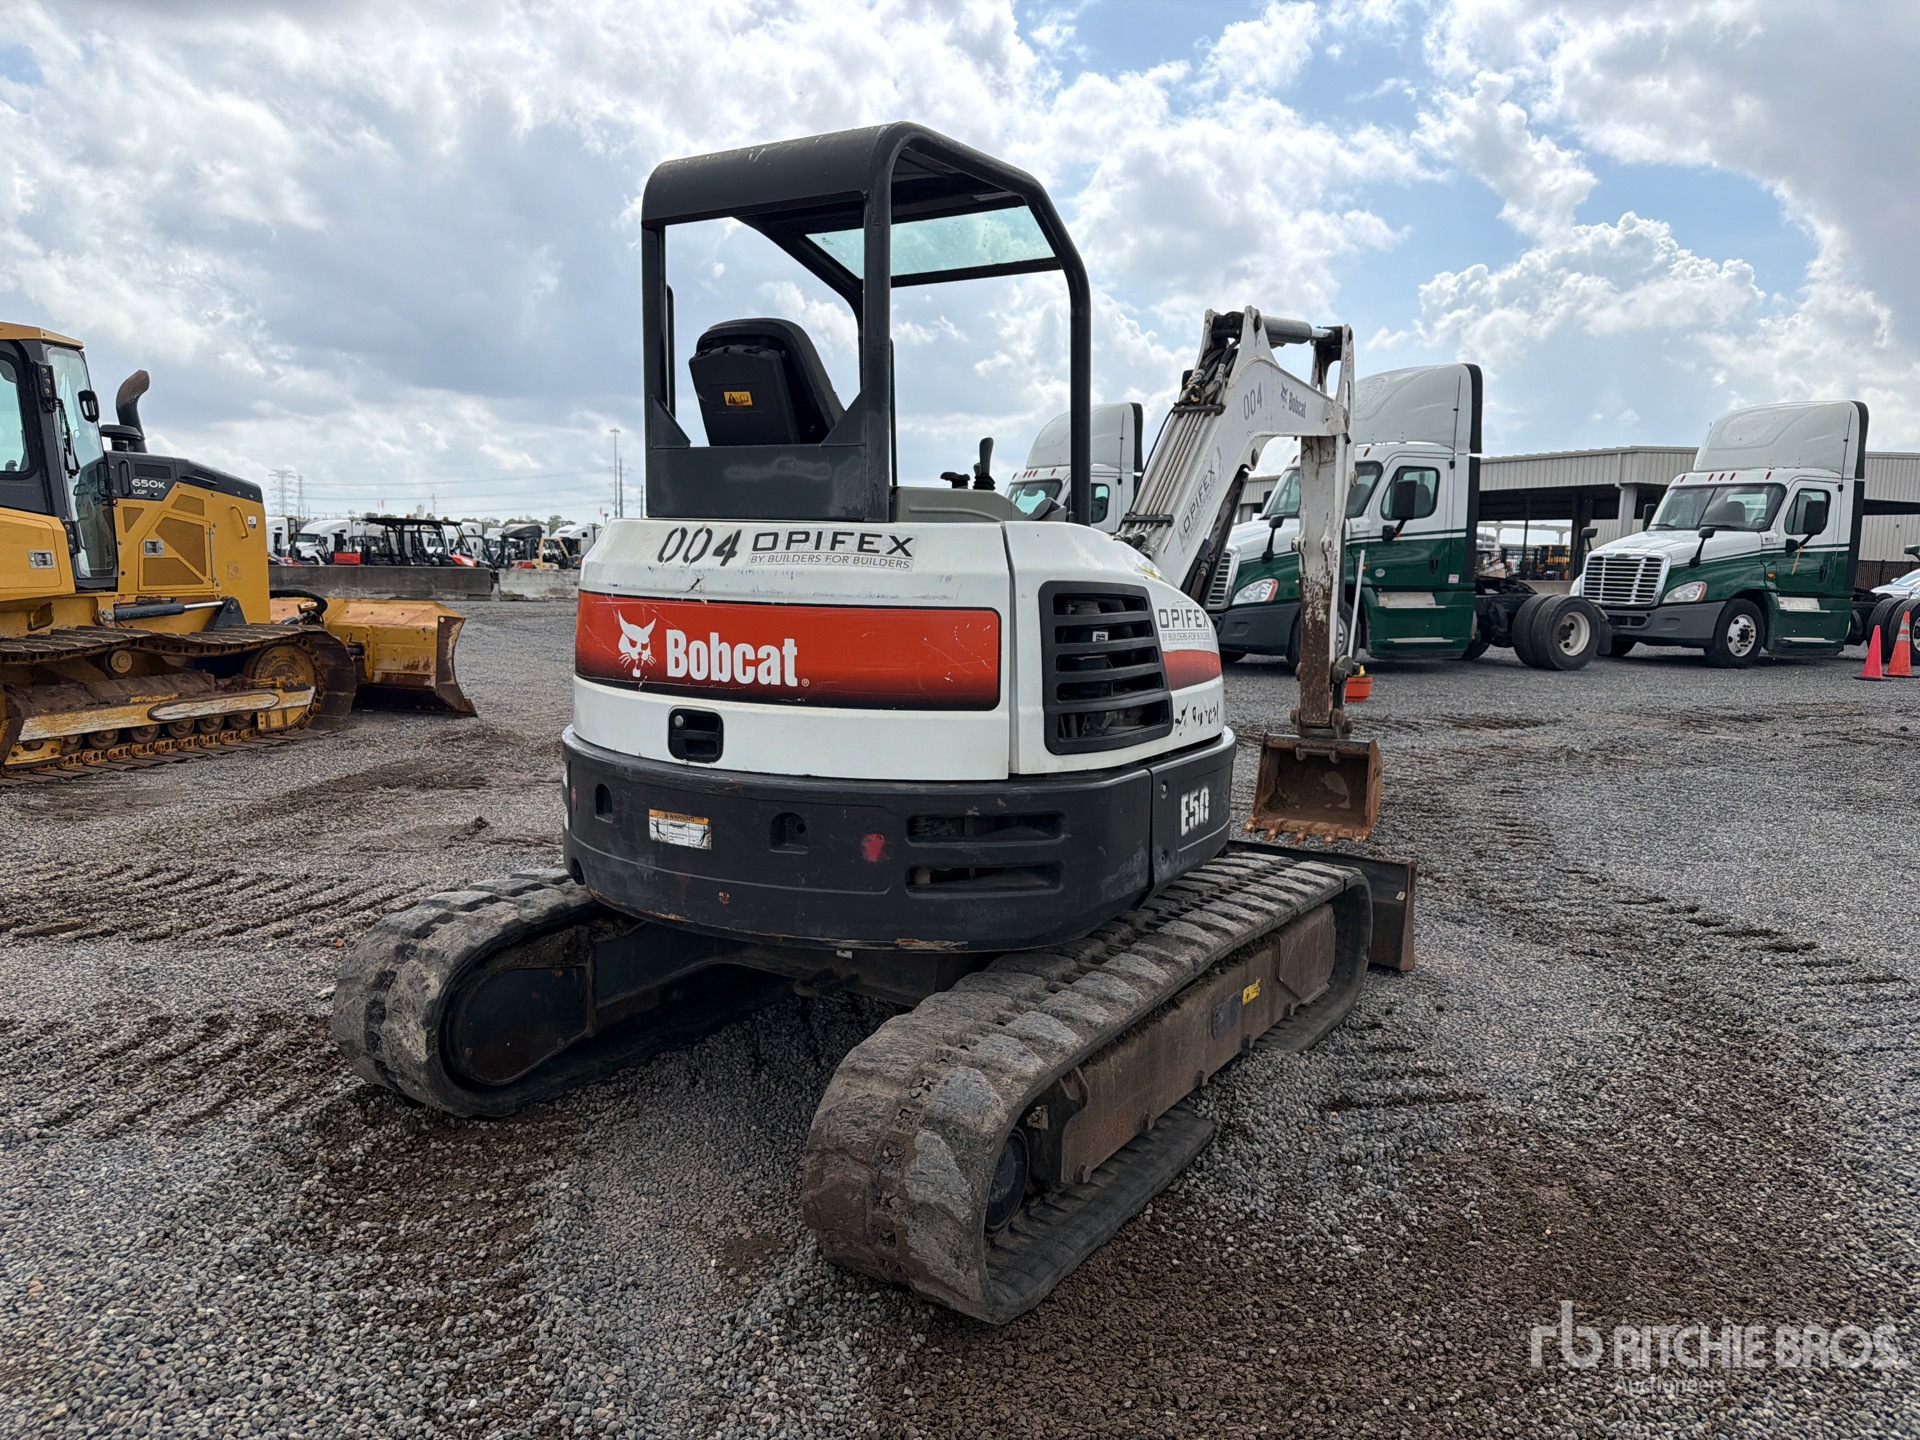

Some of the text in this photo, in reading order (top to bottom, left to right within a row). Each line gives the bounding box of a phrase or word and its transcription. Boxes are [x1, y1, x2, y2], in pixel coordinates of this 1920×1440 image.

[1243, 383, 1262, 420] 004
[132, 479, 166, 489] 650K
[657, 527, 742, 566] 004
[752, 531, 914, 557] OPIFEX
[750, 555, 910, 569] BY BUILDERS FOR BUILDERS
[1158, 608, 1210, 628] OPIFEX
[666, 629, 798, 686] Bobcat
[670, 814, 695, 822] WARNING
[1181, 786, 1209, 836] E50
